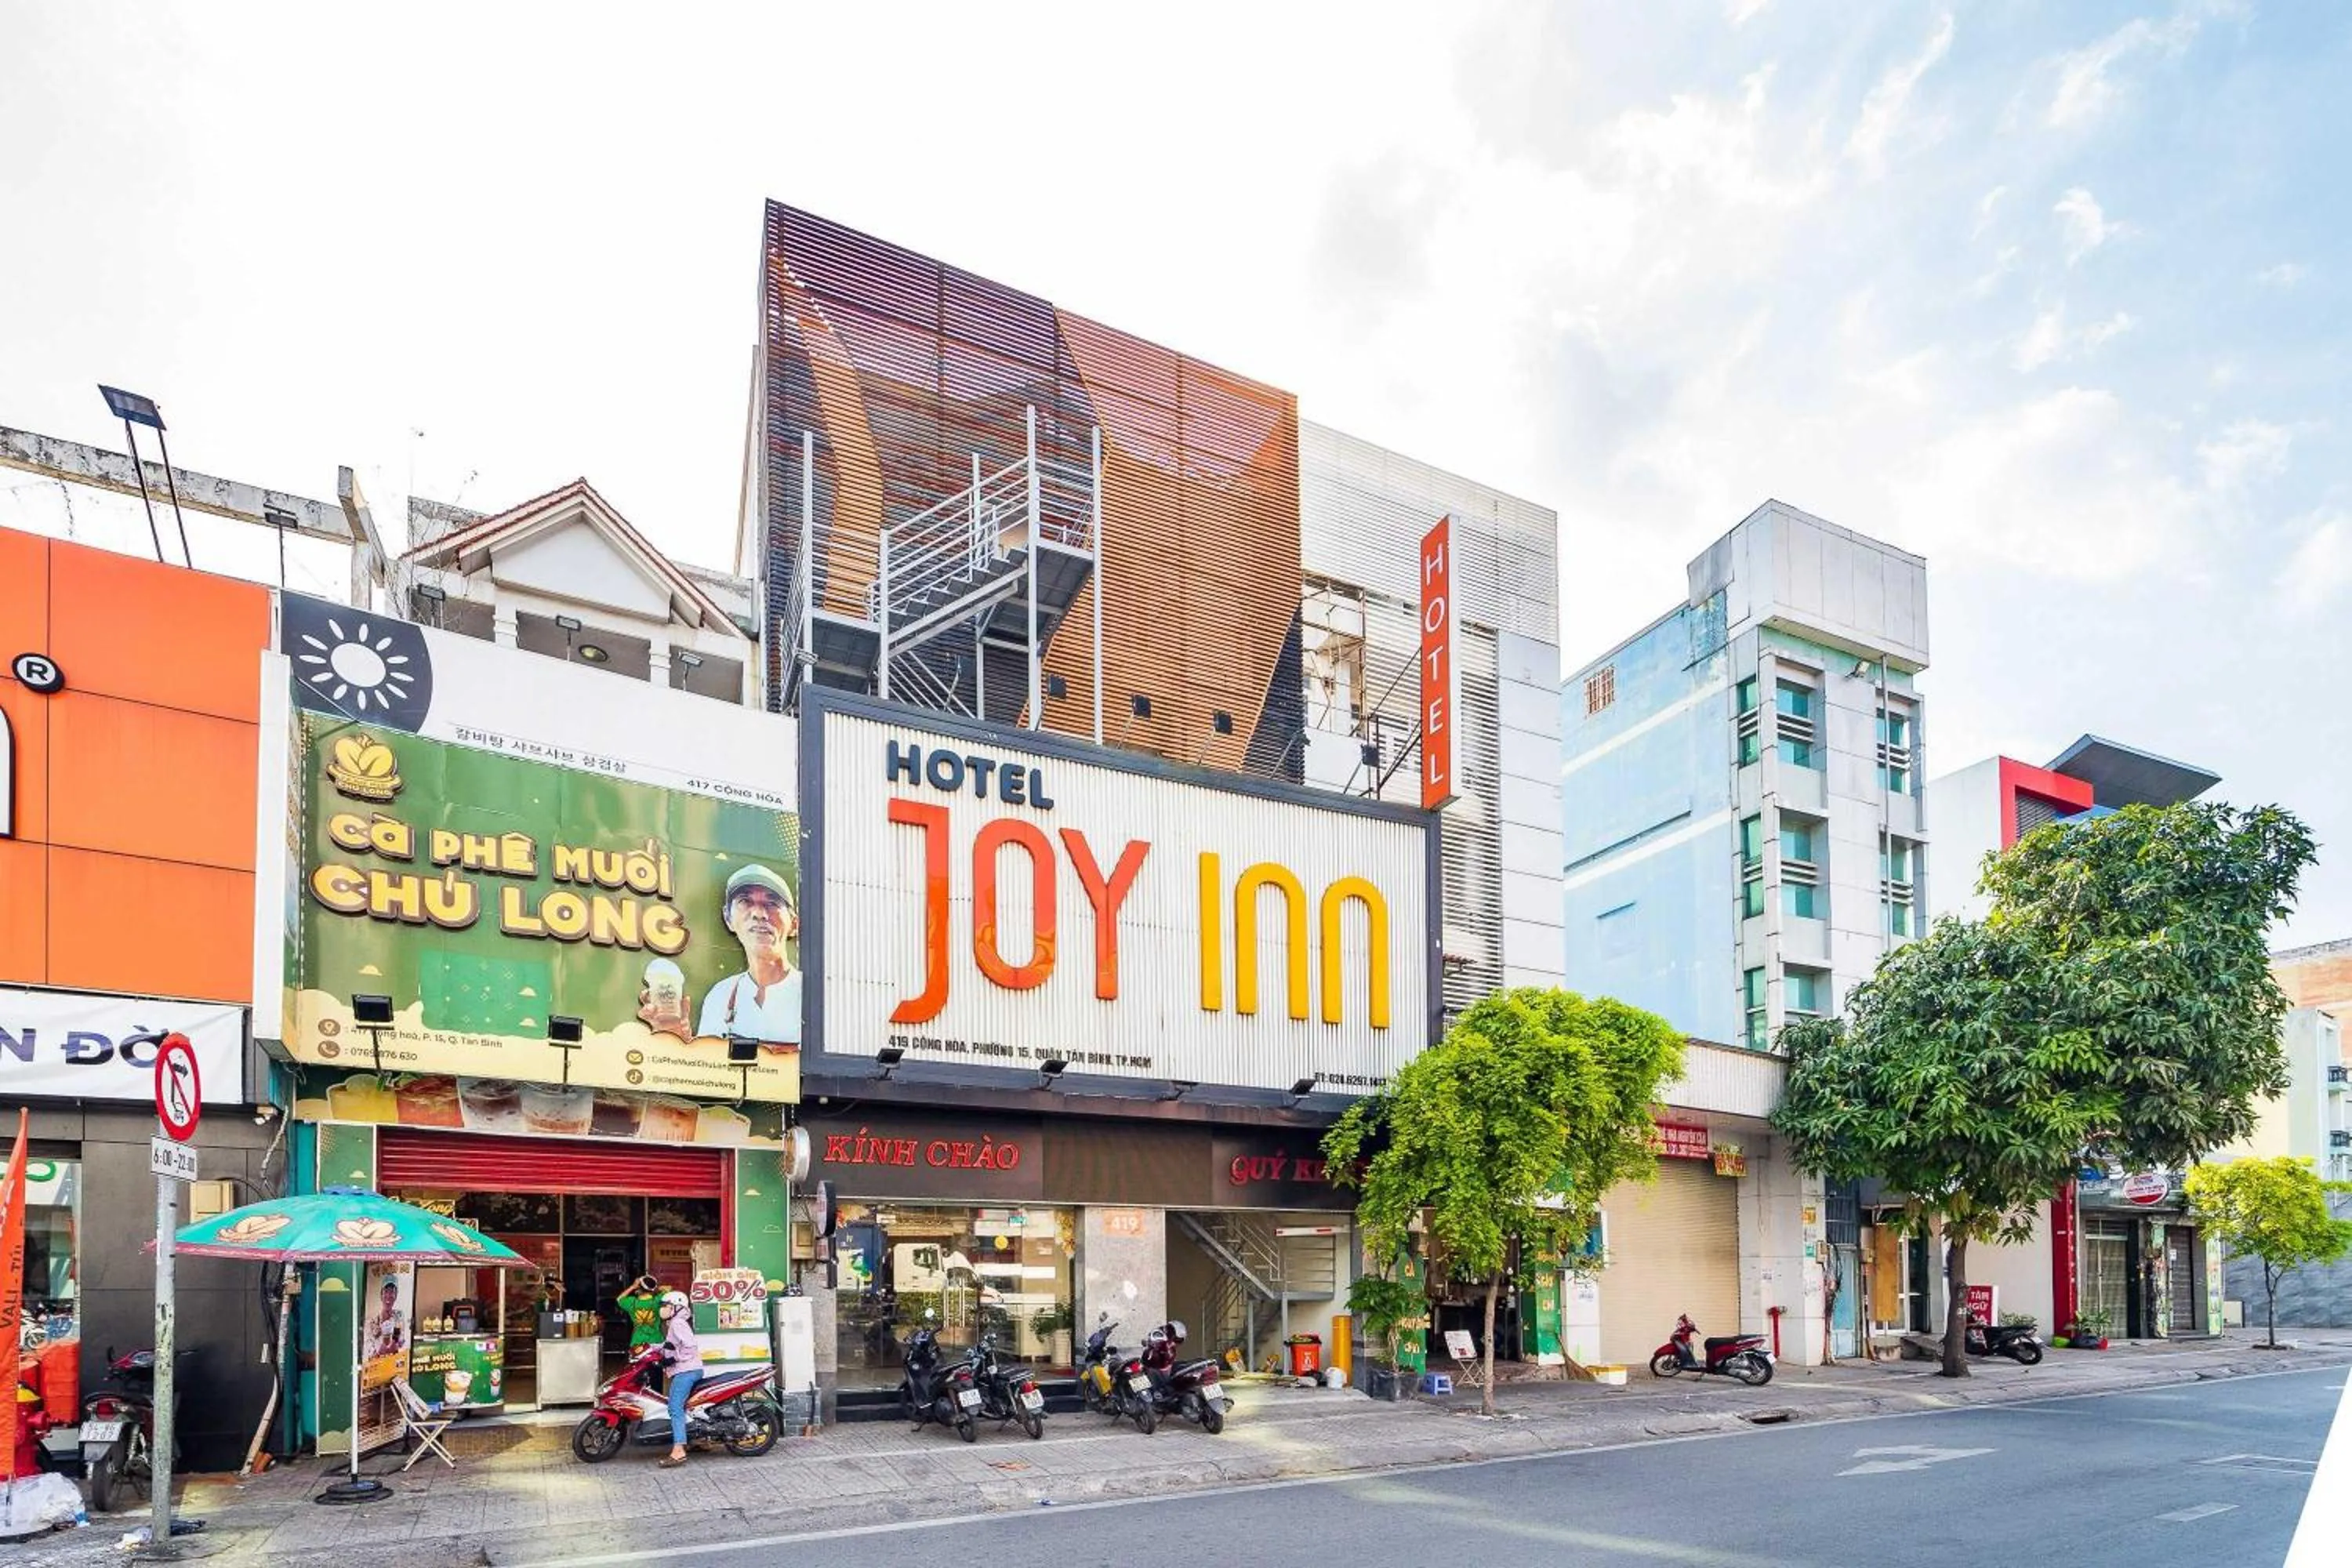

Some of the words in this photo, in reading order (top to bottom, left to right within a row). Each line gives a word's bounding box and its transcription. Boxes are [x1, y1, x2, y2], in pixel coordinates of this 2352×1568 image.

[1425, 541, 1445, 786] HOTEL
[688, 779, 710, 789] 417
[887, 739, 1054, 811] HOTEL
[430, 829, 536, 875] PHÊ
[311, 864, 478, 927] CHÚ
[500, 886, 689, 954] LONG
[888, 797, 1151, 1025] JOY
[888, 1034, 909, 1047] 419
[823, 1127, 918, 1167] KÍNH
[927, 1134, 1019, 1170] CHÀO
[1112, 1216, 1140, 1232] 419
[691, 1279, 767, 1301] 50%
